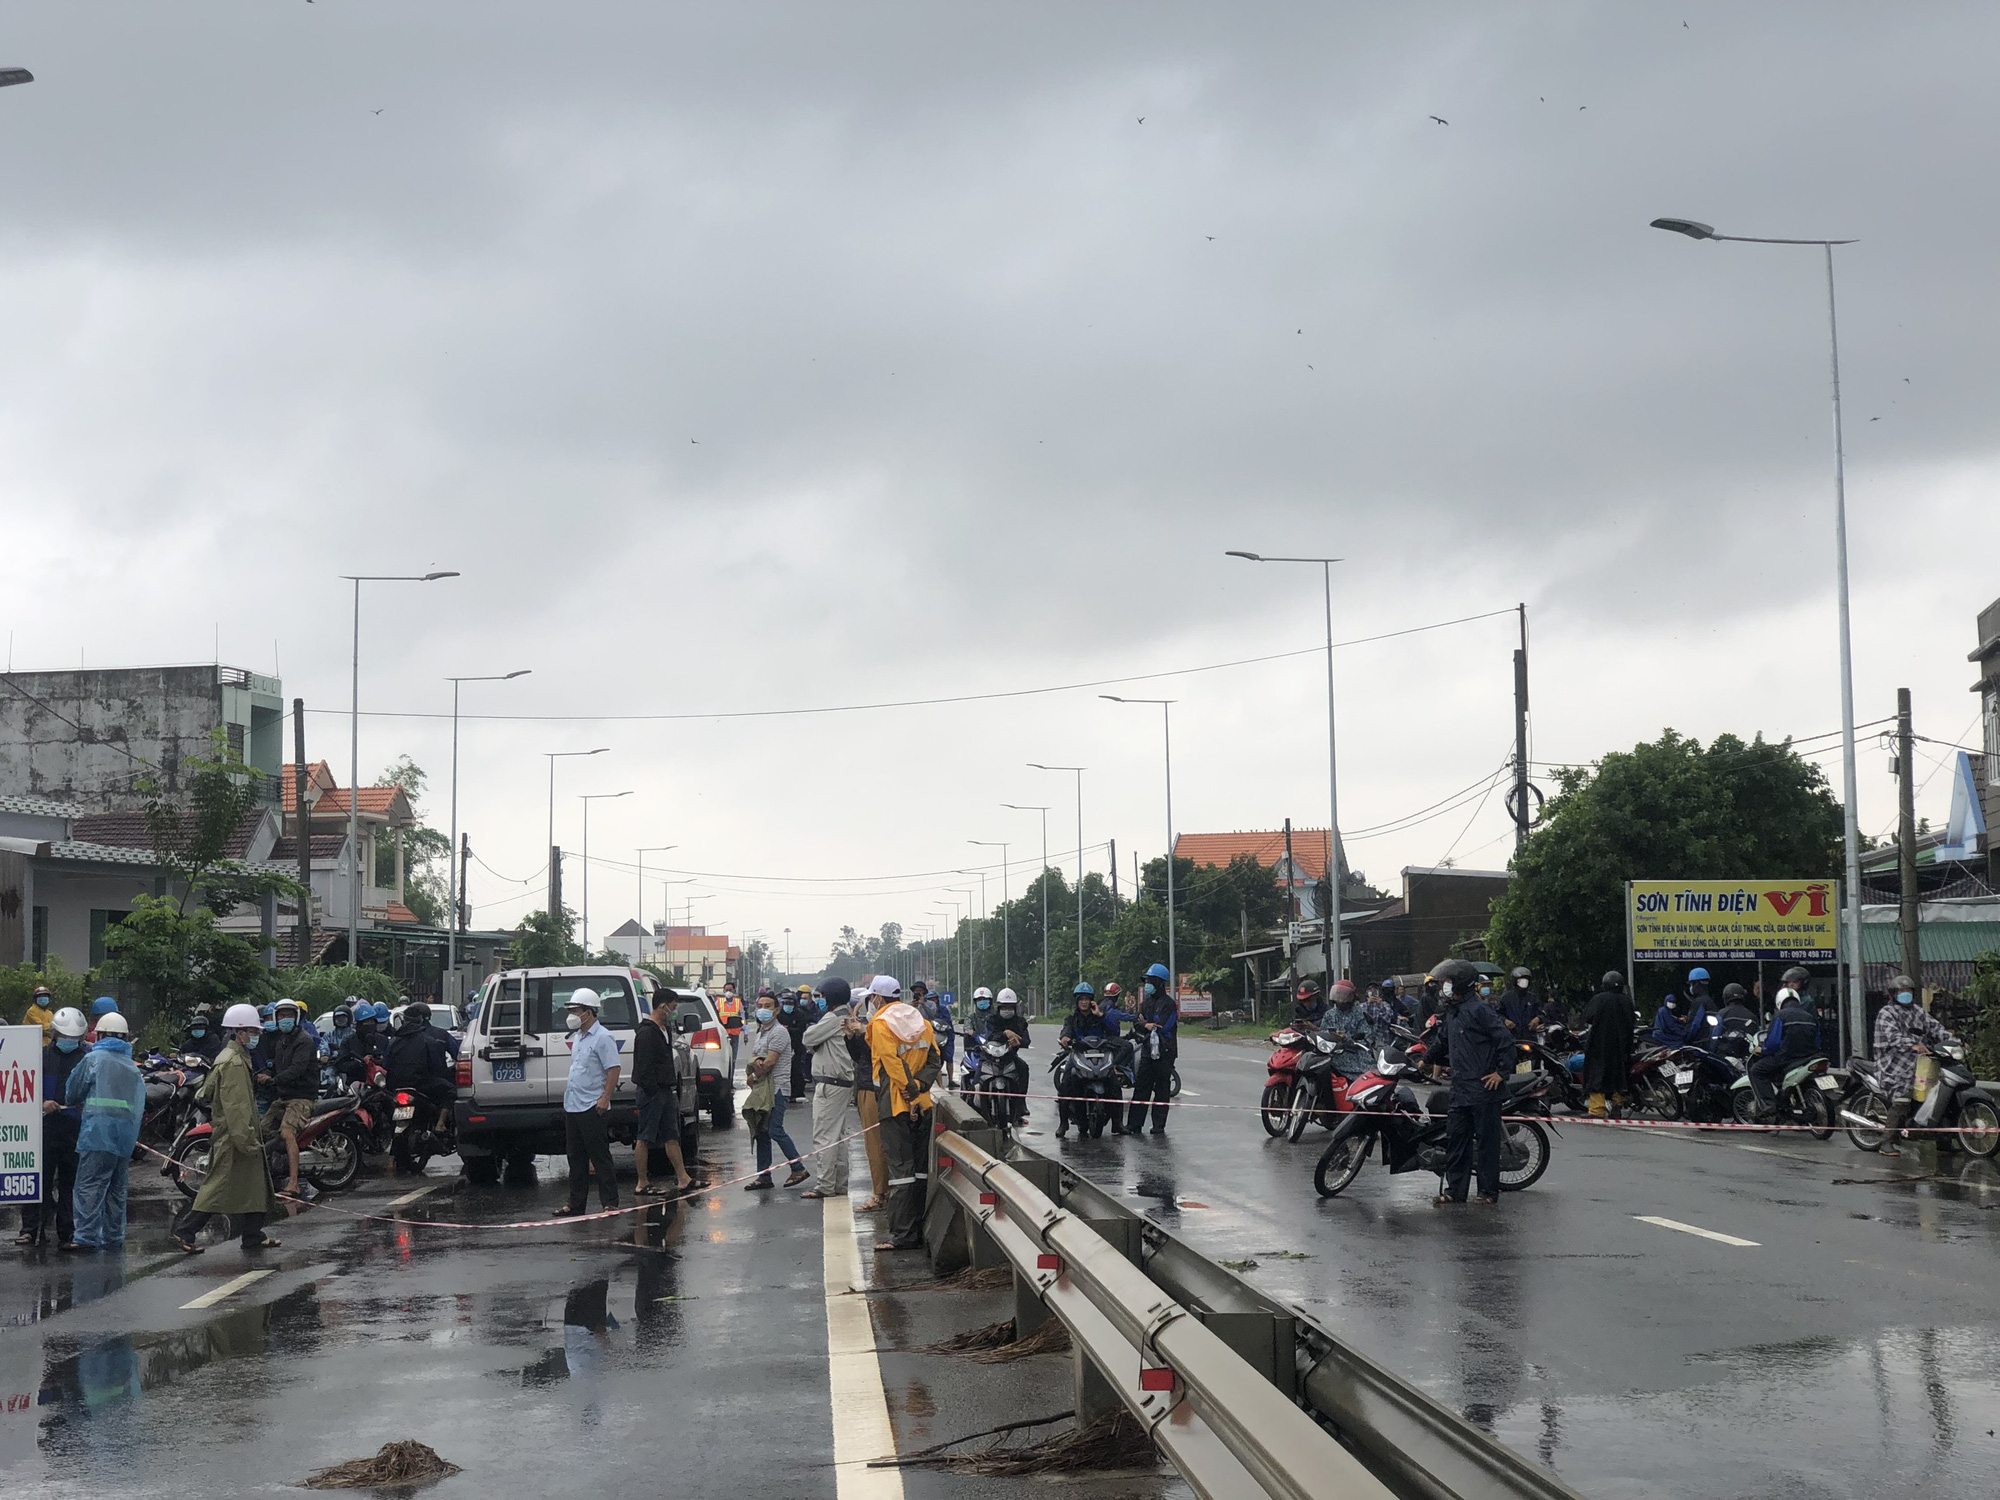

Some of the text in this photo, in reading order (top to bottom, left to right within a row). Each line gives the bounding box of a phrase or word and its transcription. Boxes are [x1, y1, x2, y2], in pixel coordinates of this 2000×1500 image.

[1636, 884, 1830, 917] SƠN TĨNH ĐIỆN VĨ
[1706, 924, 1717, 933] LAN
[1777, 924, 1786, 932] GIA
[496, 1069, 521, 1080] 0728
[3, 1151, 35, 1168] TRANG
